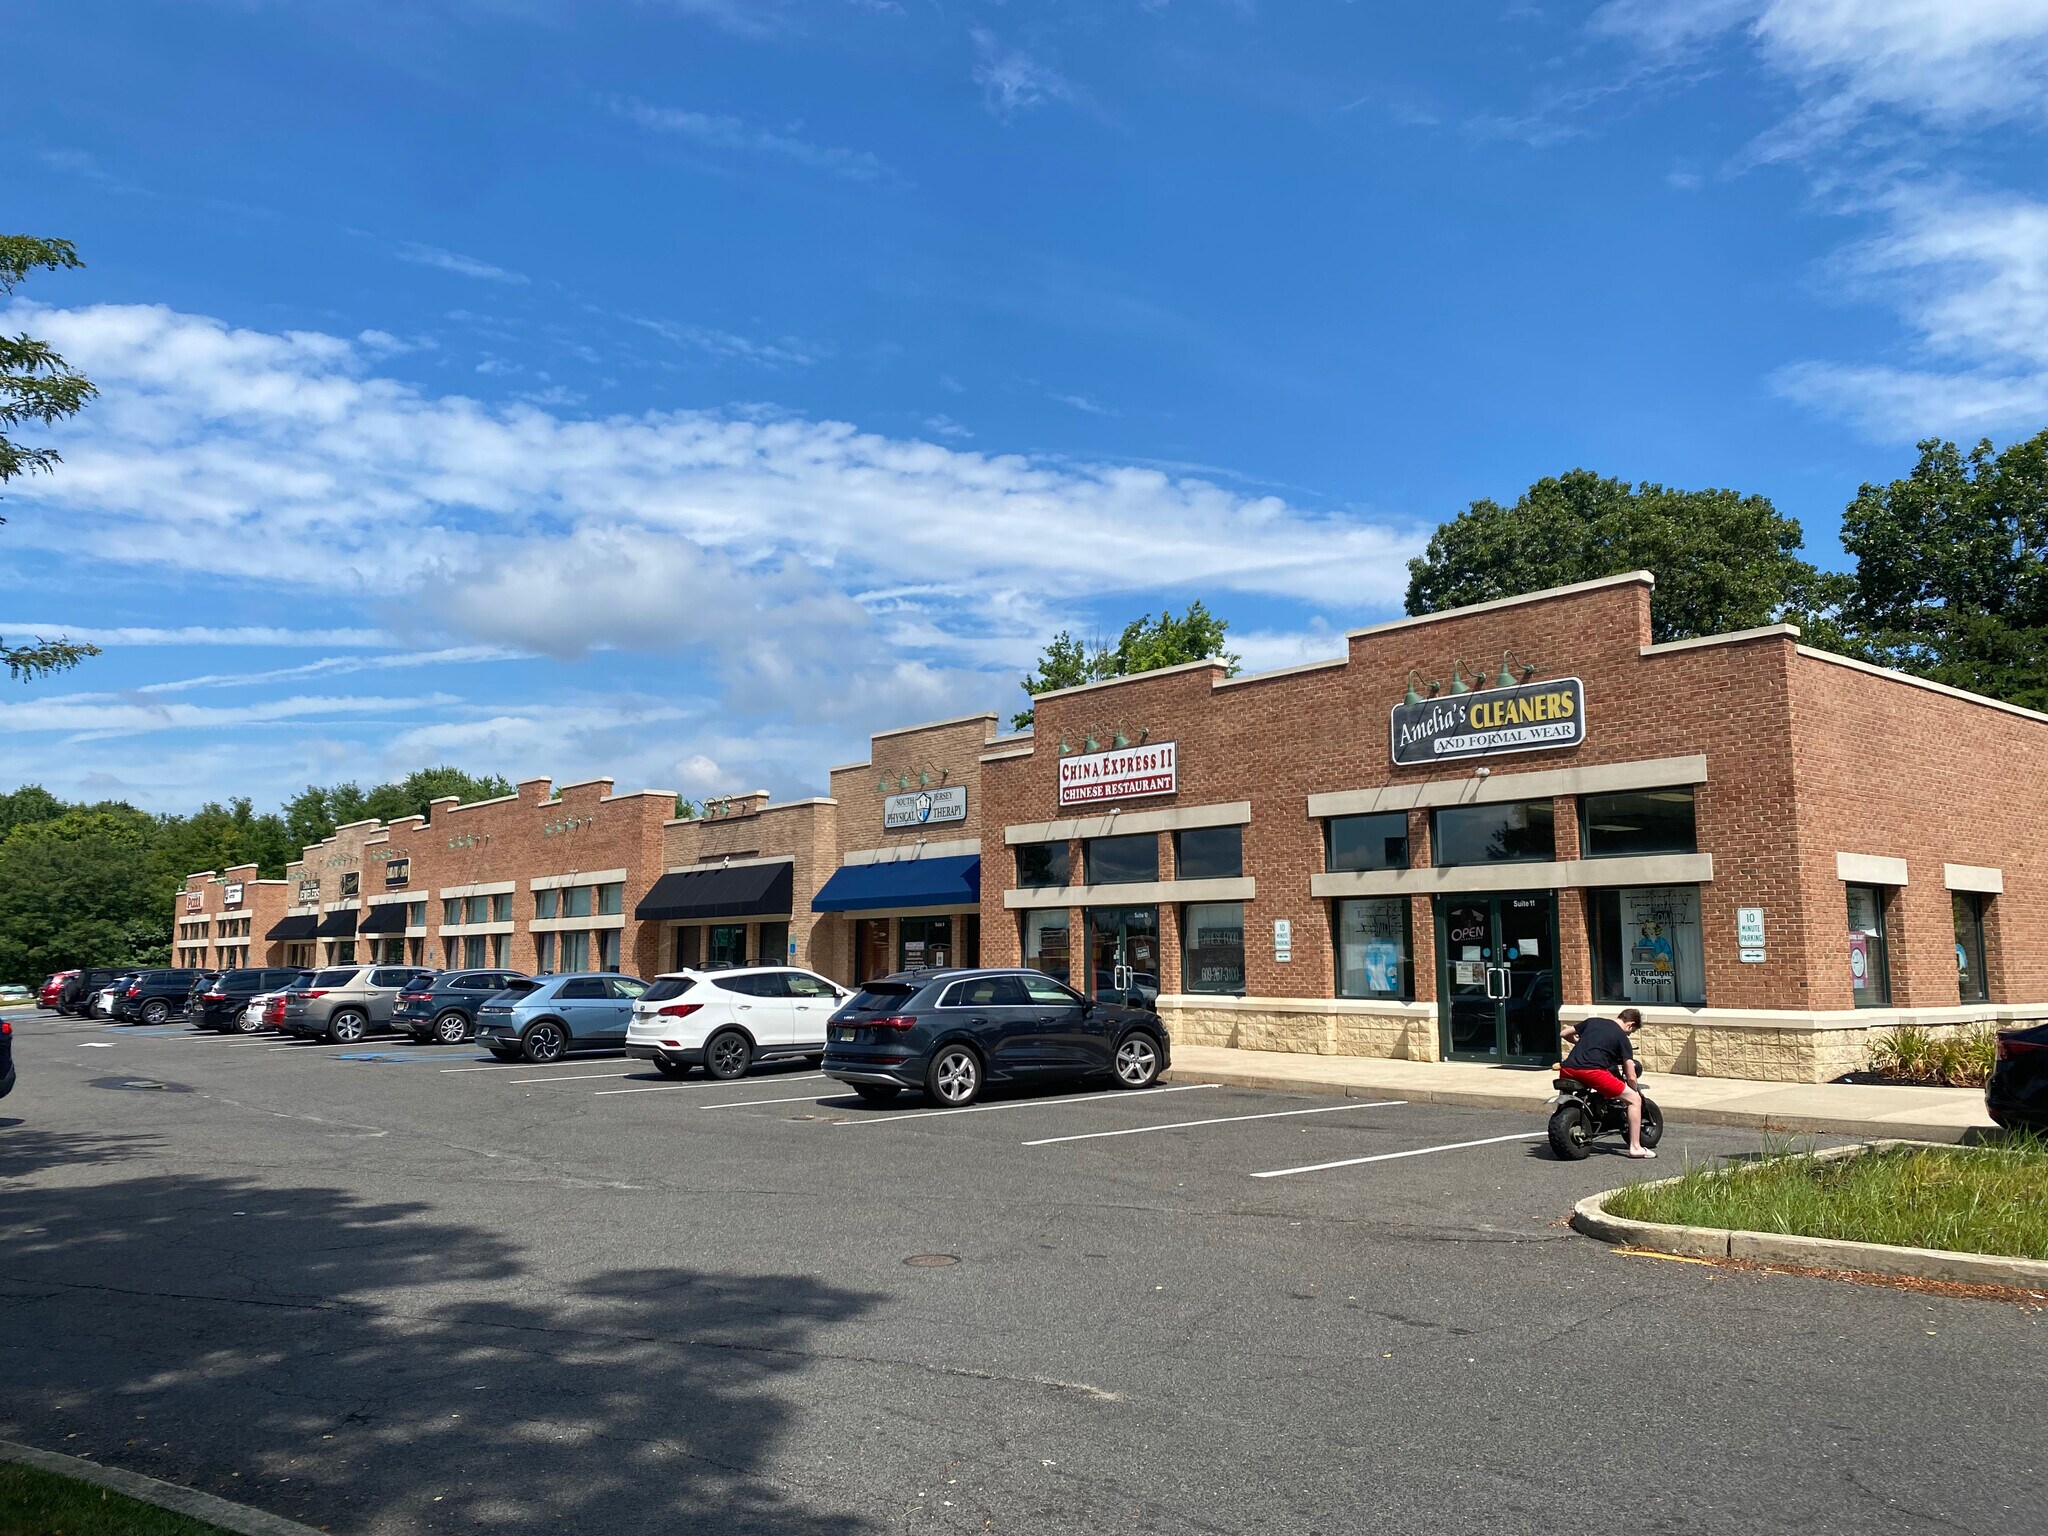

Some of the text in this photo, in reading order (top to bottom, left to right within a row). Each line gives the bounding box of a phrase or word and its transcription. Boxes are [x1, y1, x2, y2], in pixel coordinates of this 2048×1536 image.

[1400, 690, 1575, 747] Amelia's CLEANERS
[1436, 724, 1572, 752] AND FORMAL WEAR
[1062, 749, 1172, 780] CHINA EXPRESS II
[1064, 777, 1171, 800] CHINESE RESTAURANT
[896, 791, 953, 806] SOUTH JERSEY
[887, 805, 962, 824] PHYSICAL THERAPY
[1746, 913, 1755, 923] 10
[1451, 926, 1484, 941] OPEN
[1630, 968, 1675, 977] Alterations
[1633, 977, 1671, 987] & Repairs
